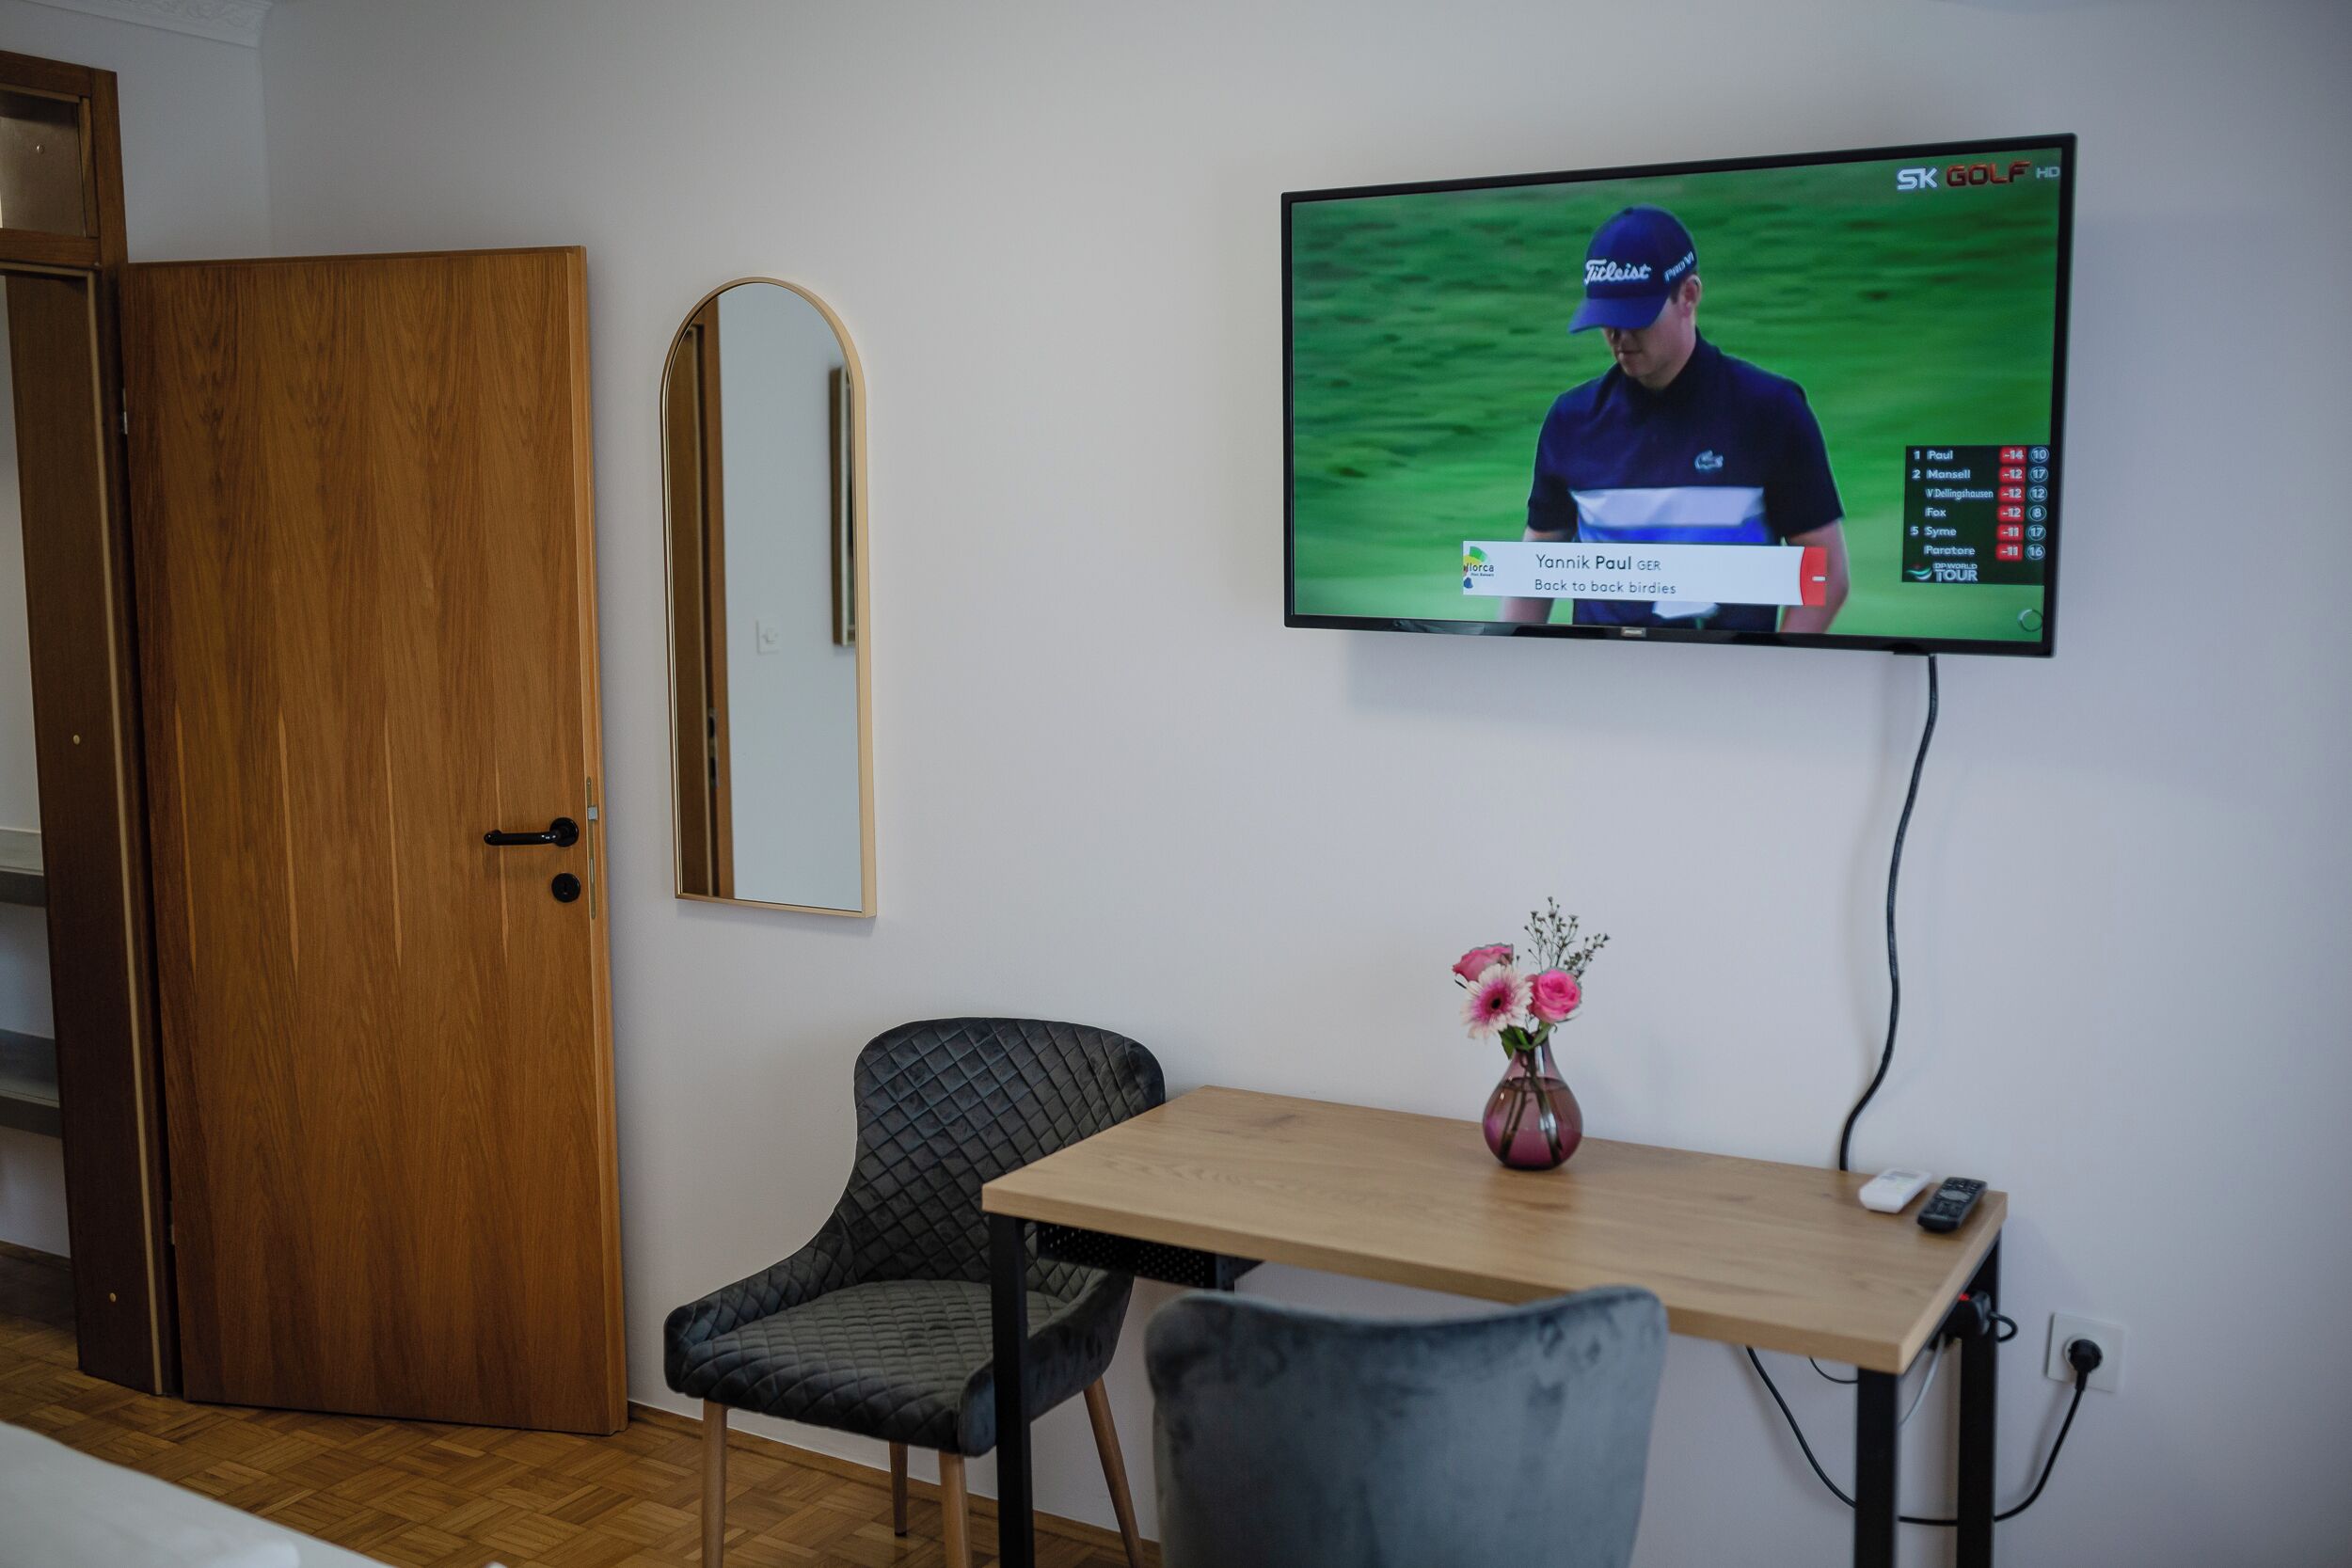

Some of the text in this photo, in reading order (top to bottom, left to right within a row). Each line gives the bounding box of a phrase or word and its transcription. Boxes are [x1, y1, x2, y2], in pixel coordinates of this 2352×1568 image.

[1897, 161, 2060, 190] SK GOLF HD
[1584, 259, 1652, 285] Titleist
[1914, 450, 1920, 460] 1
[1927, 450, 1954, 460] Paul
[2033, 449, 2047, 459] 10
[1912, 469, 1921, 479] 2
[1926, 468, 1971, 479] Mansell
[2032, 468, 2045, 479] 17
[2032, 488, 2045, 499] 12
[1925, 507, 1947, 516] Fox
[2034, 508, 2042, 518] 8
[1910, 527, 1919, 536] 5
[1924, 526, 1957, 539] Syme
[2030, 527, 2043, 537] 17
[1924, 545, 1976, 555] Paratore
[2028, 546, 2042, 557] 16
[1535, 554, 1661, 570] Yannik Paul GER
[1934, 569, 1978, 582] TOUR
[1534, 578, 1677, 594] Back to back birdies
